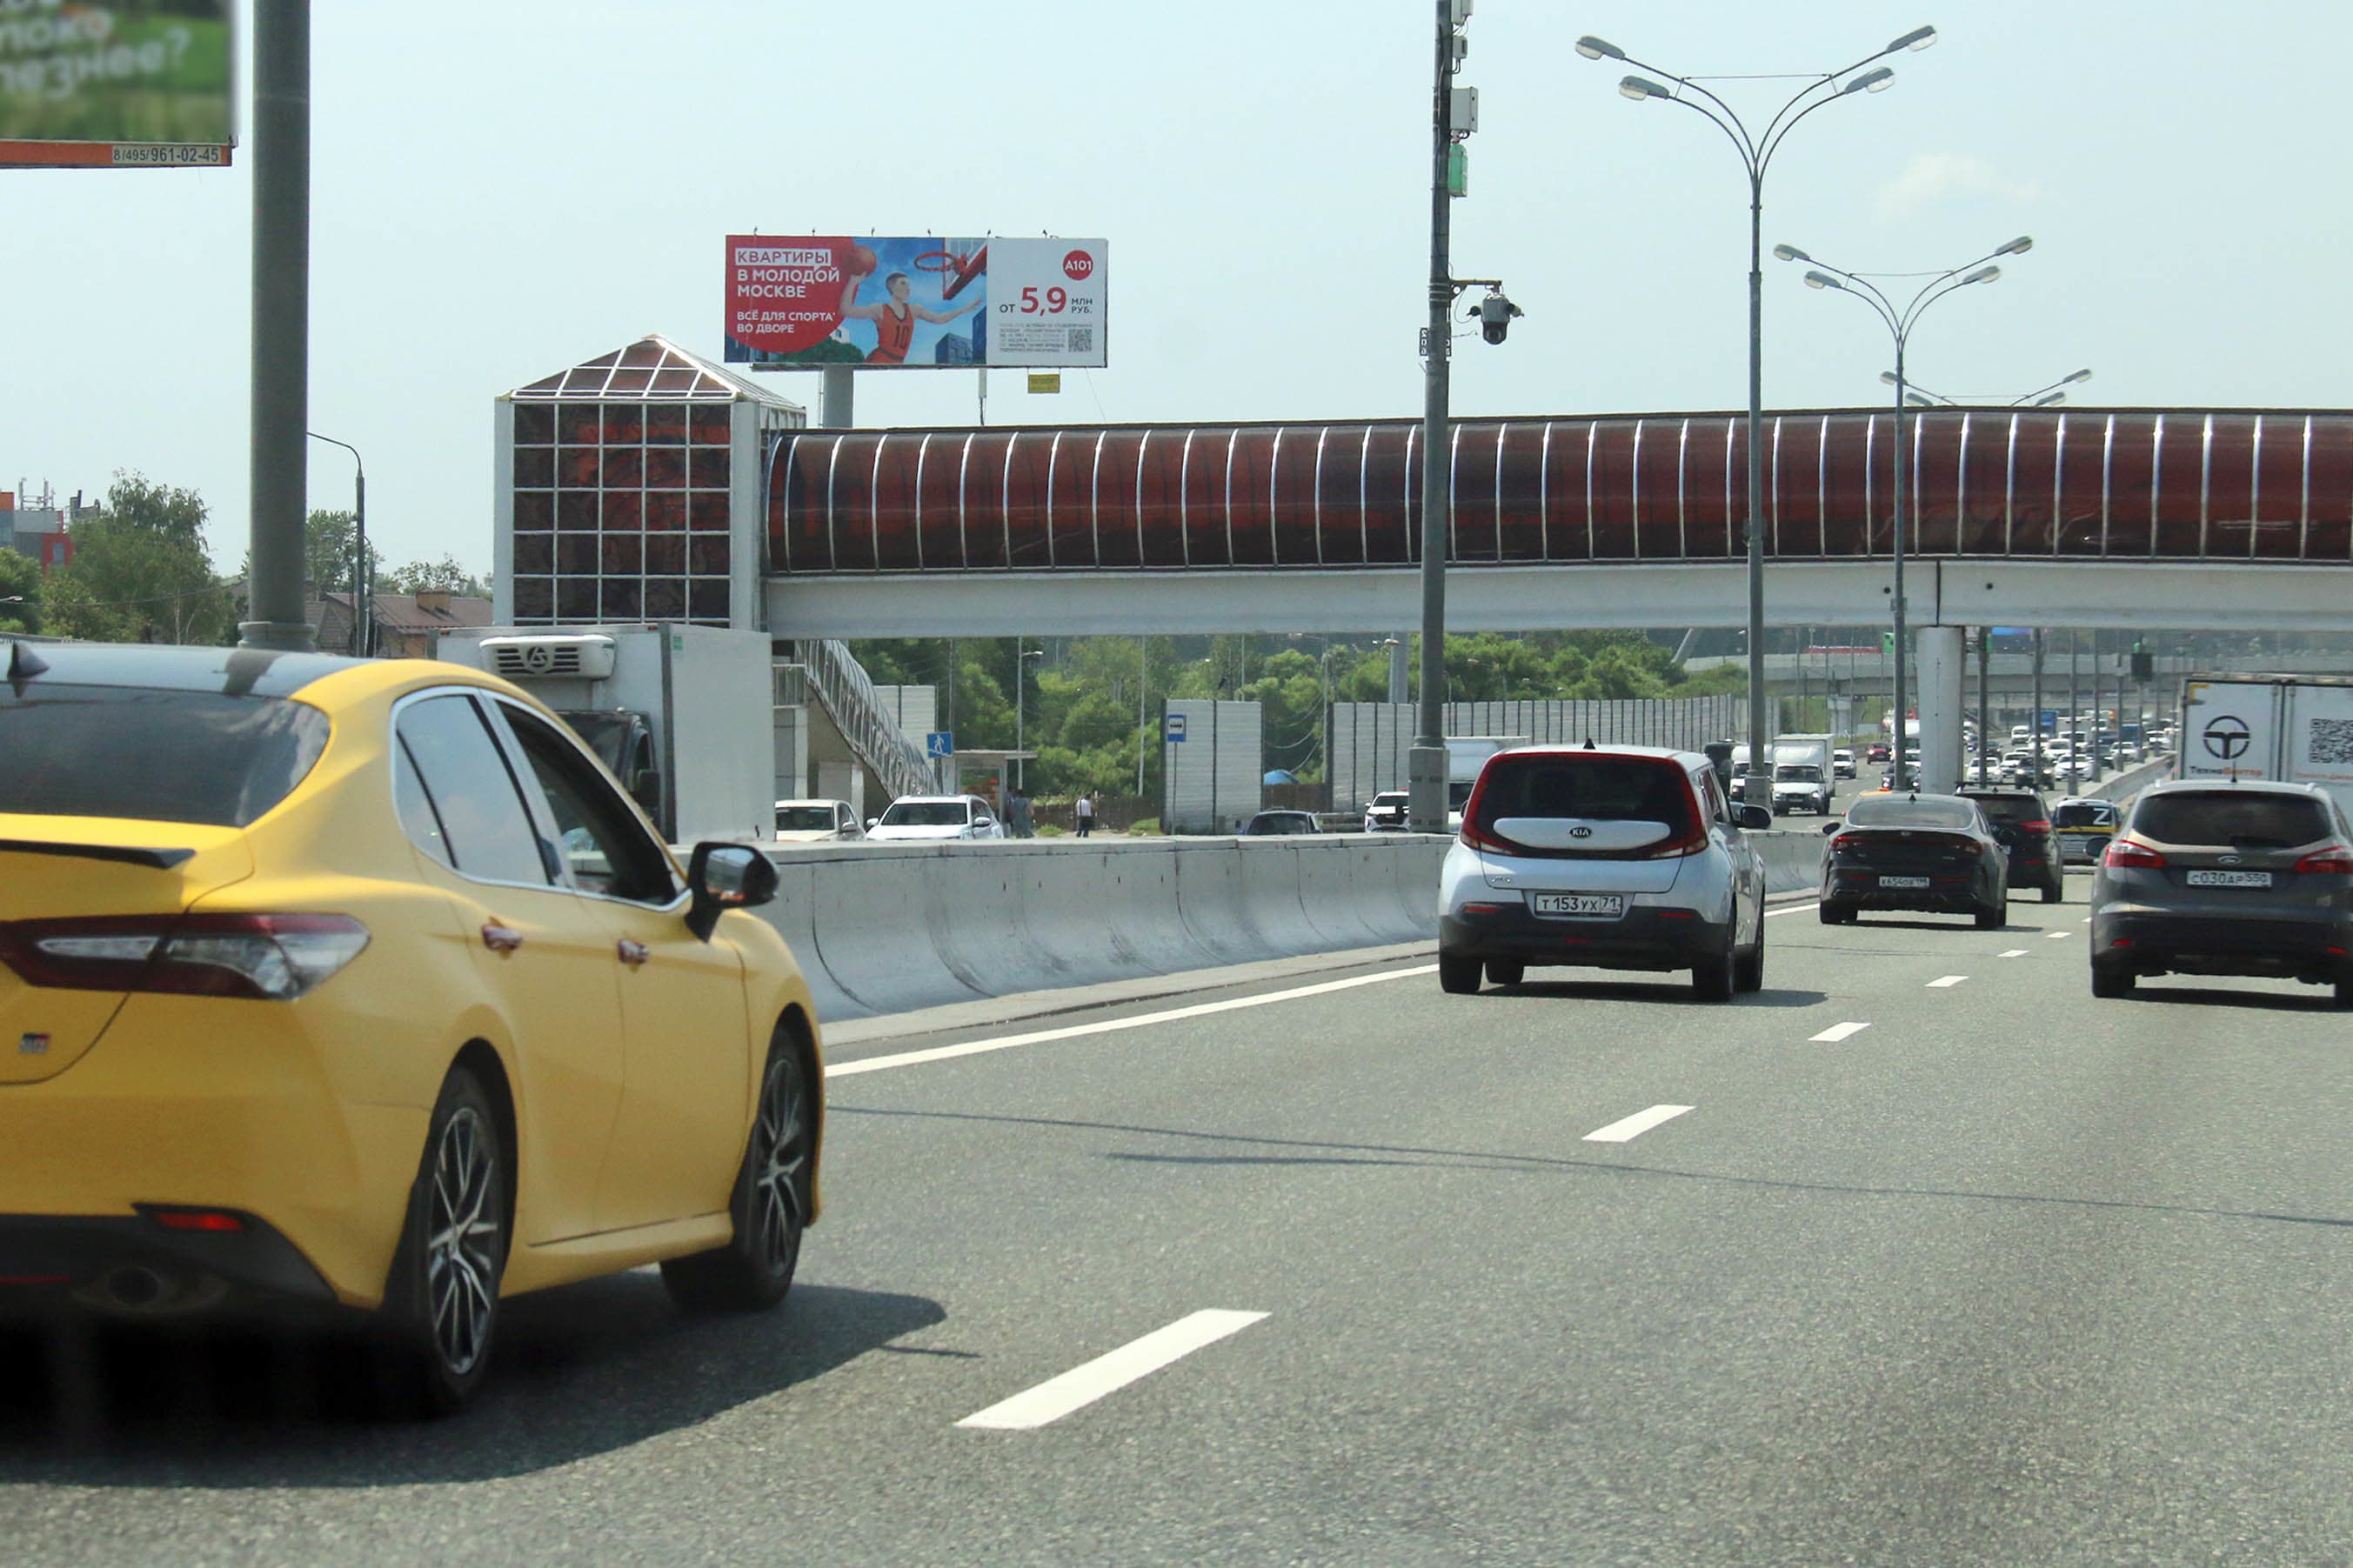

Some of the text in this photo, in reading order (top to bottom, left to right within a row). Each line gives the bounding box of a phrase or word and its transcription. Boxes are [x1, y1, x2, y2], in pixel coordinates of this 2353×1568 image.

[113, 148, 218, 163] 8/495/961-02-45
[738, 251, 828, 264] КВАРТИРЫ
[737, 267, 840, 284] В МОЛОДОЙ
[737, 285, 806, 298] МОСКВЕ
[999, 304, 1015, 313] ОТ
[1020, 286, 1066, 317] 5,9
[737, 310, 758, 321] ВСЁ
[761, 312, 785, 322] ДЛЯ
[737, 324, 794, 334] ВО ДВОРЕ
[2093, 807, 2109, 825] Z
[1572, 827, 1589, 836] KIA
